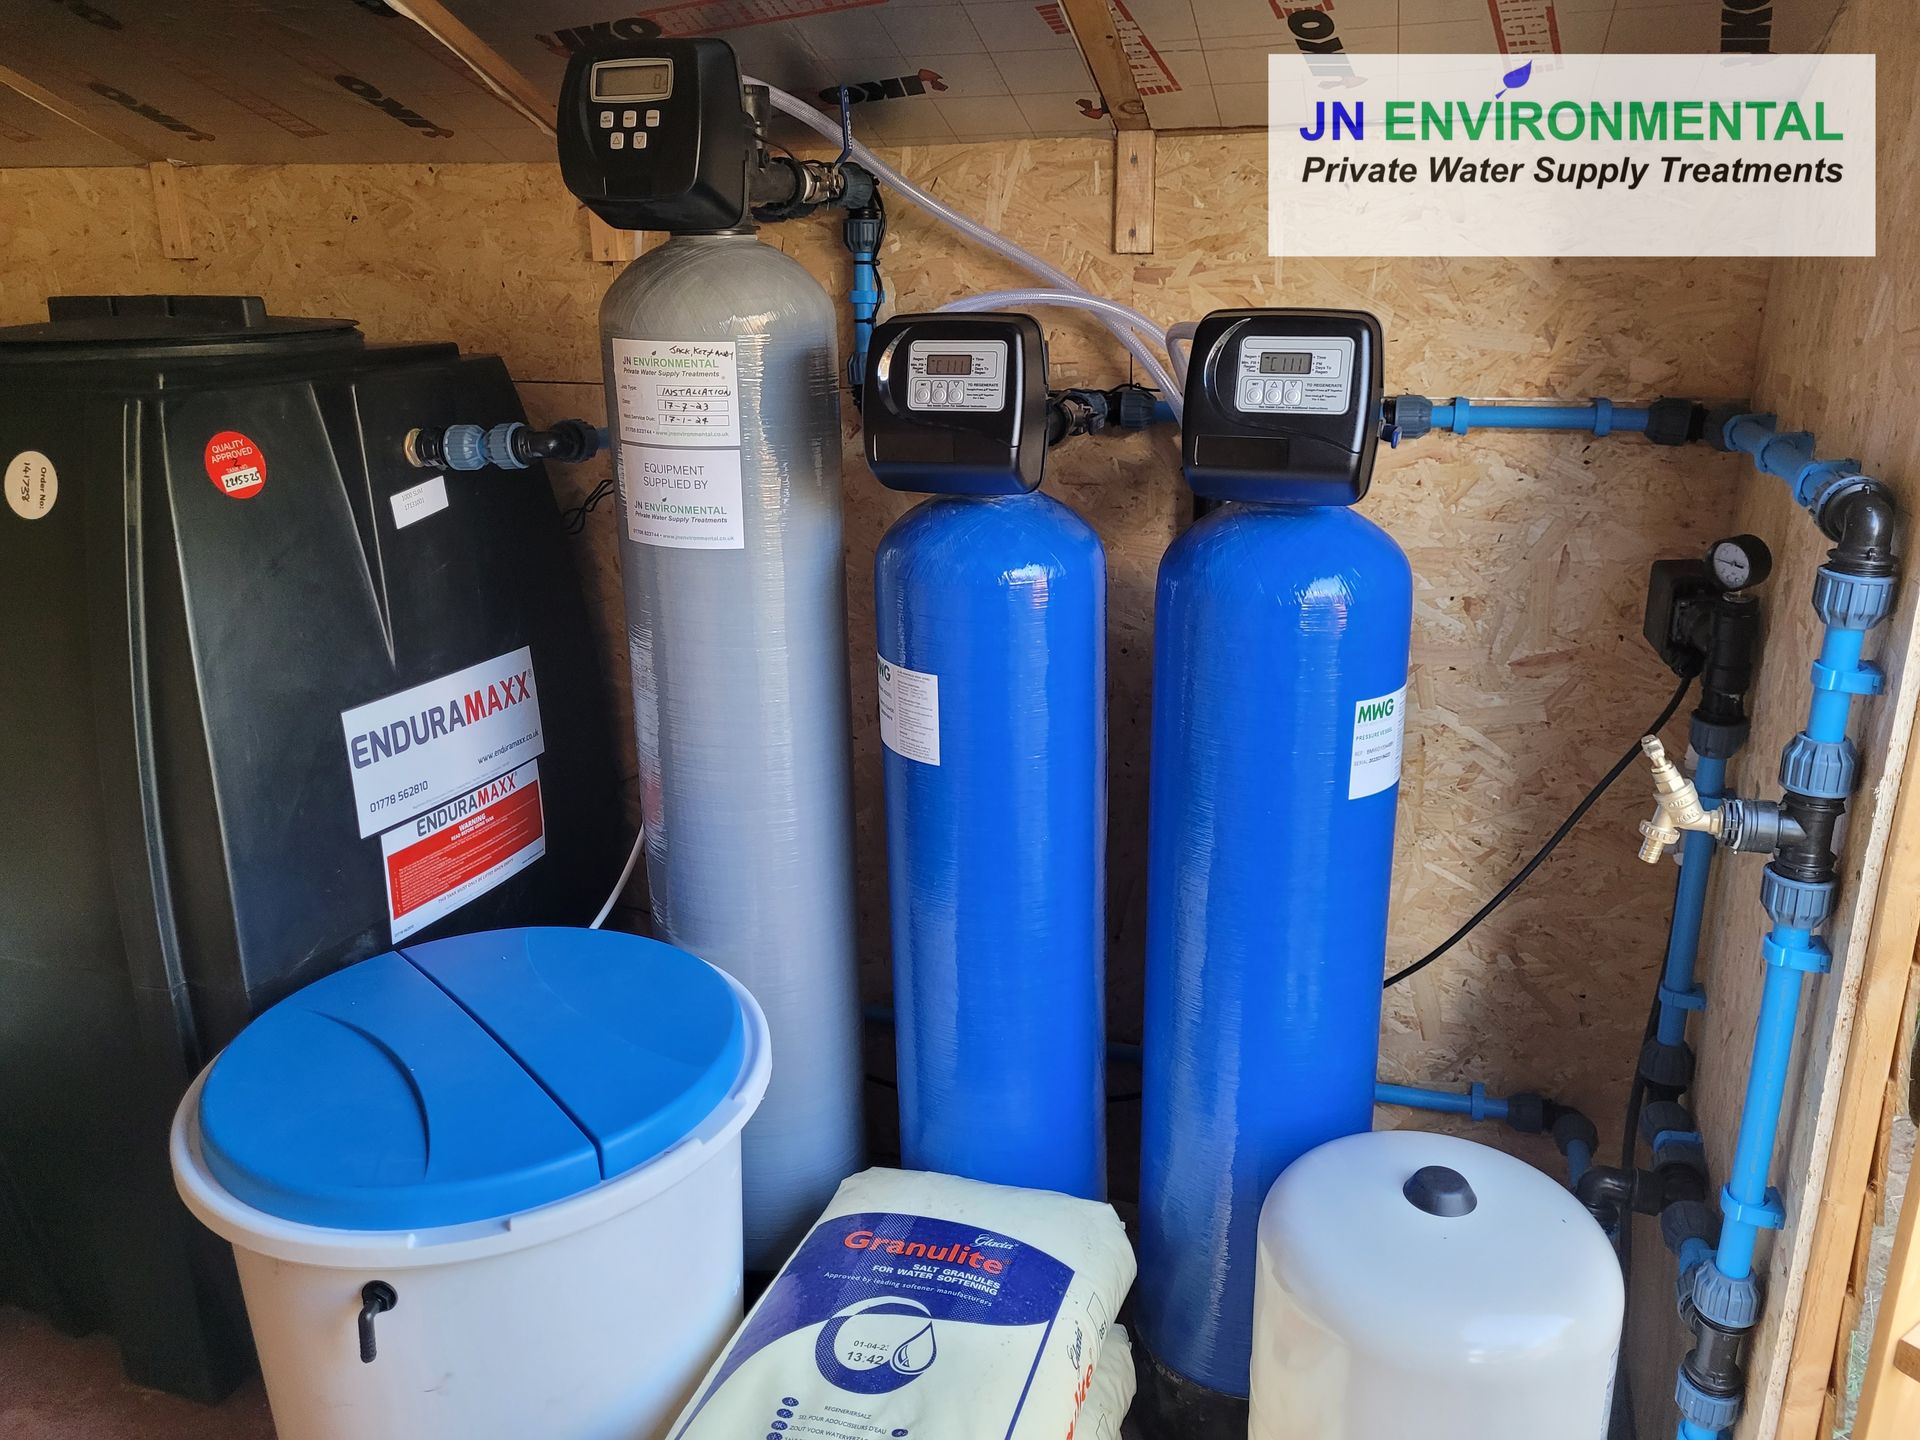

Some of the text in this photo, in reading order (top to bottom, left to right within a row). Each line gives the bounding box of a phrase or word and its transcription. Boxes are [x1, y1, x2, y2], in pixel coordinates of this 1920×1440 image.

[623, 356, 719, 368] JN ENVIRONMENTAL
[658, 370, 679, 378] Supply
[682, 370, 719, 378] Treatments
[212, 439, 244, 453] QUALITY
[211, 447, 252, 464] APPROVED
[644, 463, 704, 475] EQUIPMENT
[643, 476, 708, 489] SUPPLIED BY
[634, 500, 727, 514] JN ENVIRONMENTAL
[668, 515, 689, 523] Supply
[351, 671, 531, 769] ENDURAMAXX
[1357, 698, 1394, 724] MWG
[477, 729, 539, 765] www.enduramaxx.co.uk
[370, 791, 396, 813] 01778
[398, 780, 429, 801] 562810
[416, 773, 516, 837] ENDURAMAXX
[459, 812, 486, 831] WARNING
[844, 1230, 1004, 1274] Granulite
[872, 1264, 999, 1296] FOR WATER SOFTENING
[912, 1263, 1000, 1289] SALT GRANULES
[824, 1271, 993, 1307] Approved by leading softener manufacturers
[847, 1351, 884, 1365] 13:42
[807, 1427, 824, 1435] VOOR
